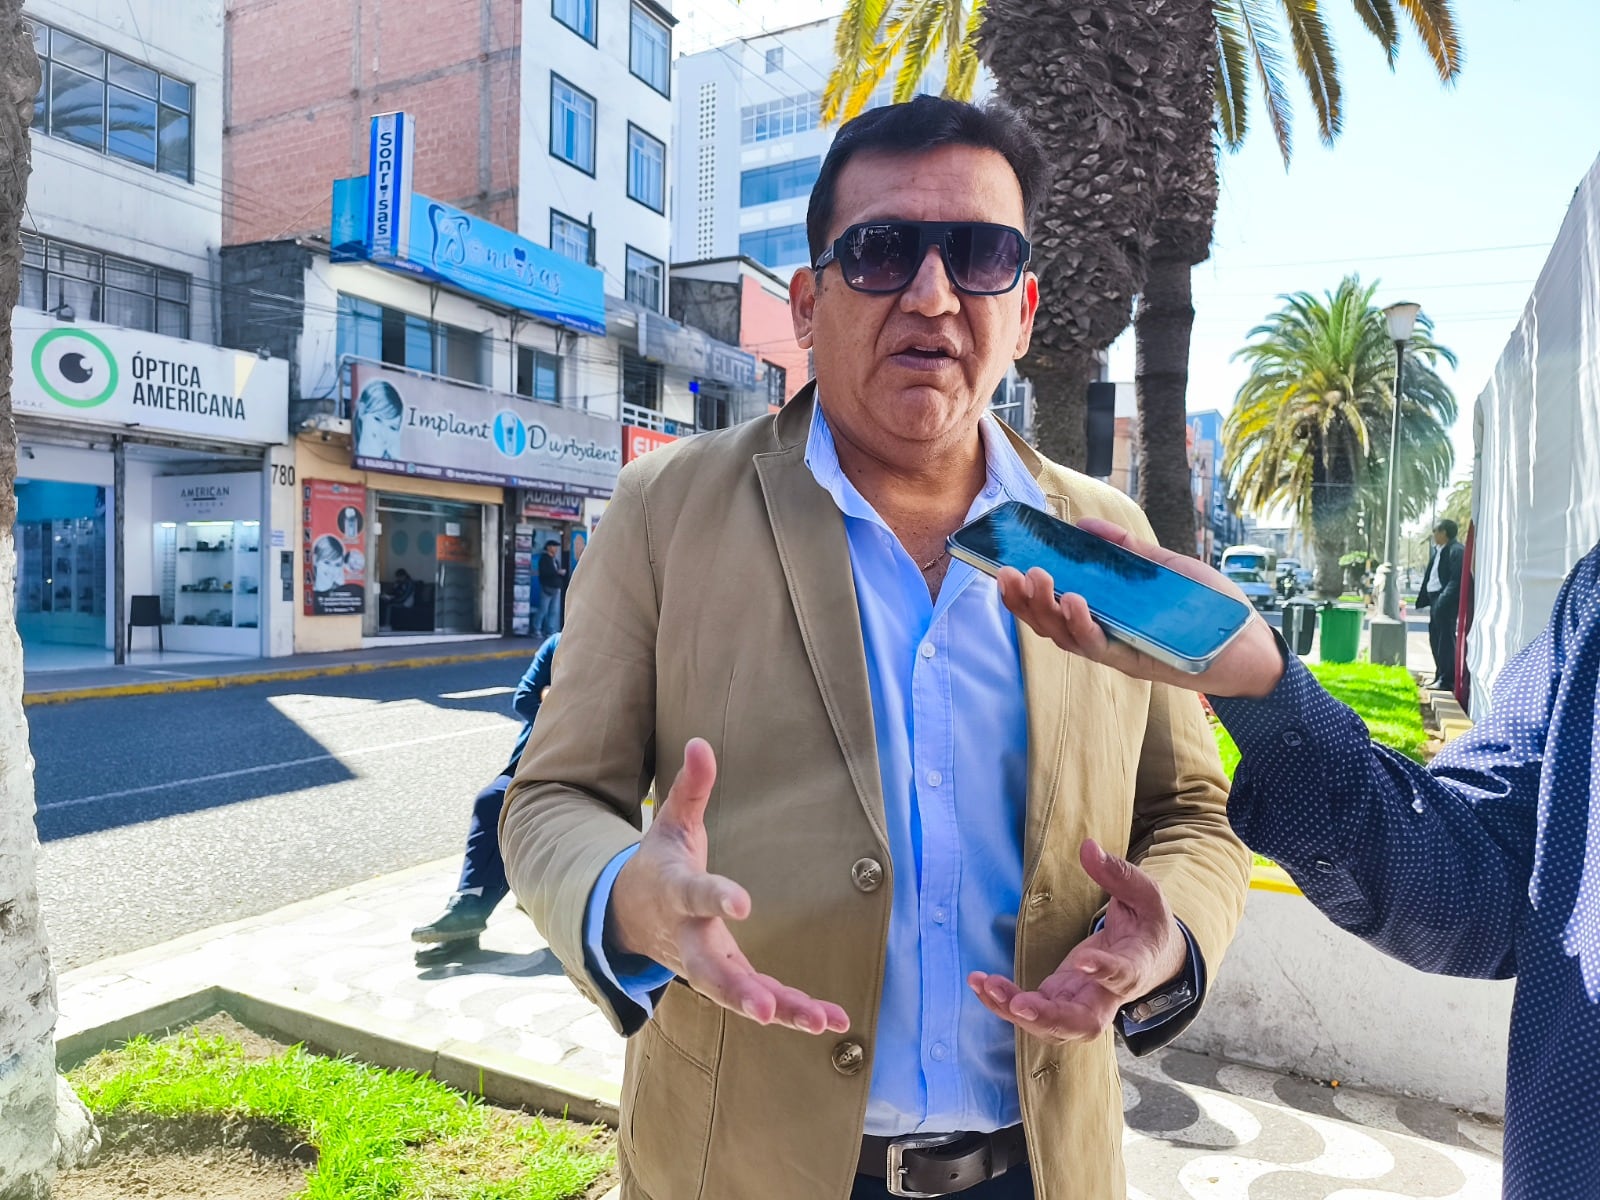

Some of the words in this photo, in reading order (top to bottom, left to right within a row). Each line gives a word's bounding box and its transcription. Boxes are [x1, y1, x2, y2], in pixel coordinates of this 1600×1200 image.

[131, 351, 202, 389] ÓPTICA
[132, 382, 247, 421] AMERICANA
[407, 406, 491, 438] Implant
[527, 424, 620, 464] Durbydent
[181, 486, 230, 498] AMERICAN
[271, 464, 296, 487] 780
